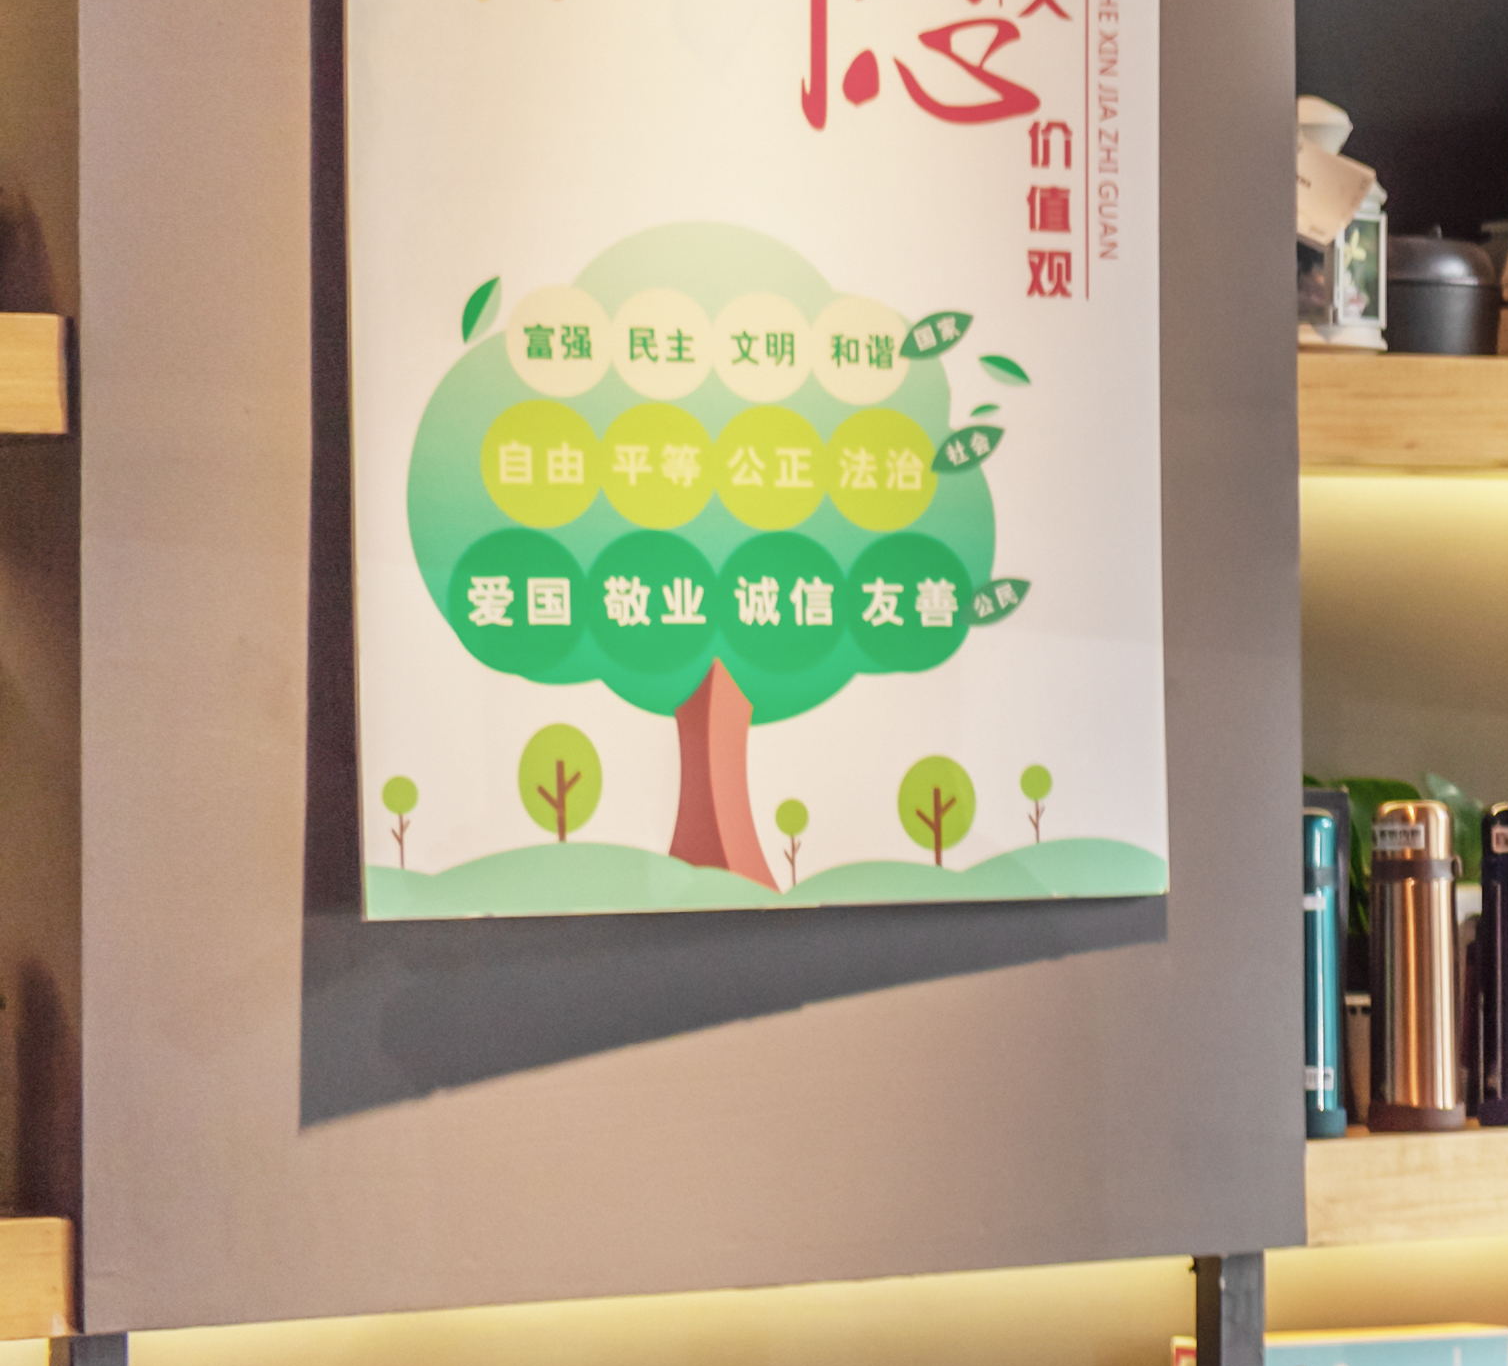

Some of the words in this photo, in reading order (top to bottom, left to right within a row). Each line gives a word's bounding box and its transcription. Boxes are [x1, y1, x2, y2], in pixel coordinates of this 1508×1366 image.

[1097, 30, 1121, 78] XIN
[1097, 84, 1121, 123] JIA
[1097, 130, 1121, 175] ZHI
[1025, 119, 1075, 299] 价值观
[1097, 185, 1121, 261] GUAN
[522, 323, 594, 363] 富强
[628, 327, 696, 365] 民主
[729, 329, 797, 368] 文明
[829, 332, 897, 372] 和谐
[497, 439, 586, 486] 自由
[612, 442, 703, 489] 平等
[726, 445, 815, 490] 公正
[838, 446, 925, 493] 法治
[466, 574, 573, 628] 爱国
[602, 574, 708, 628] 敬业
[733, 575, 836, 629] 诚信
[860, 577, 960, 629] 友善
